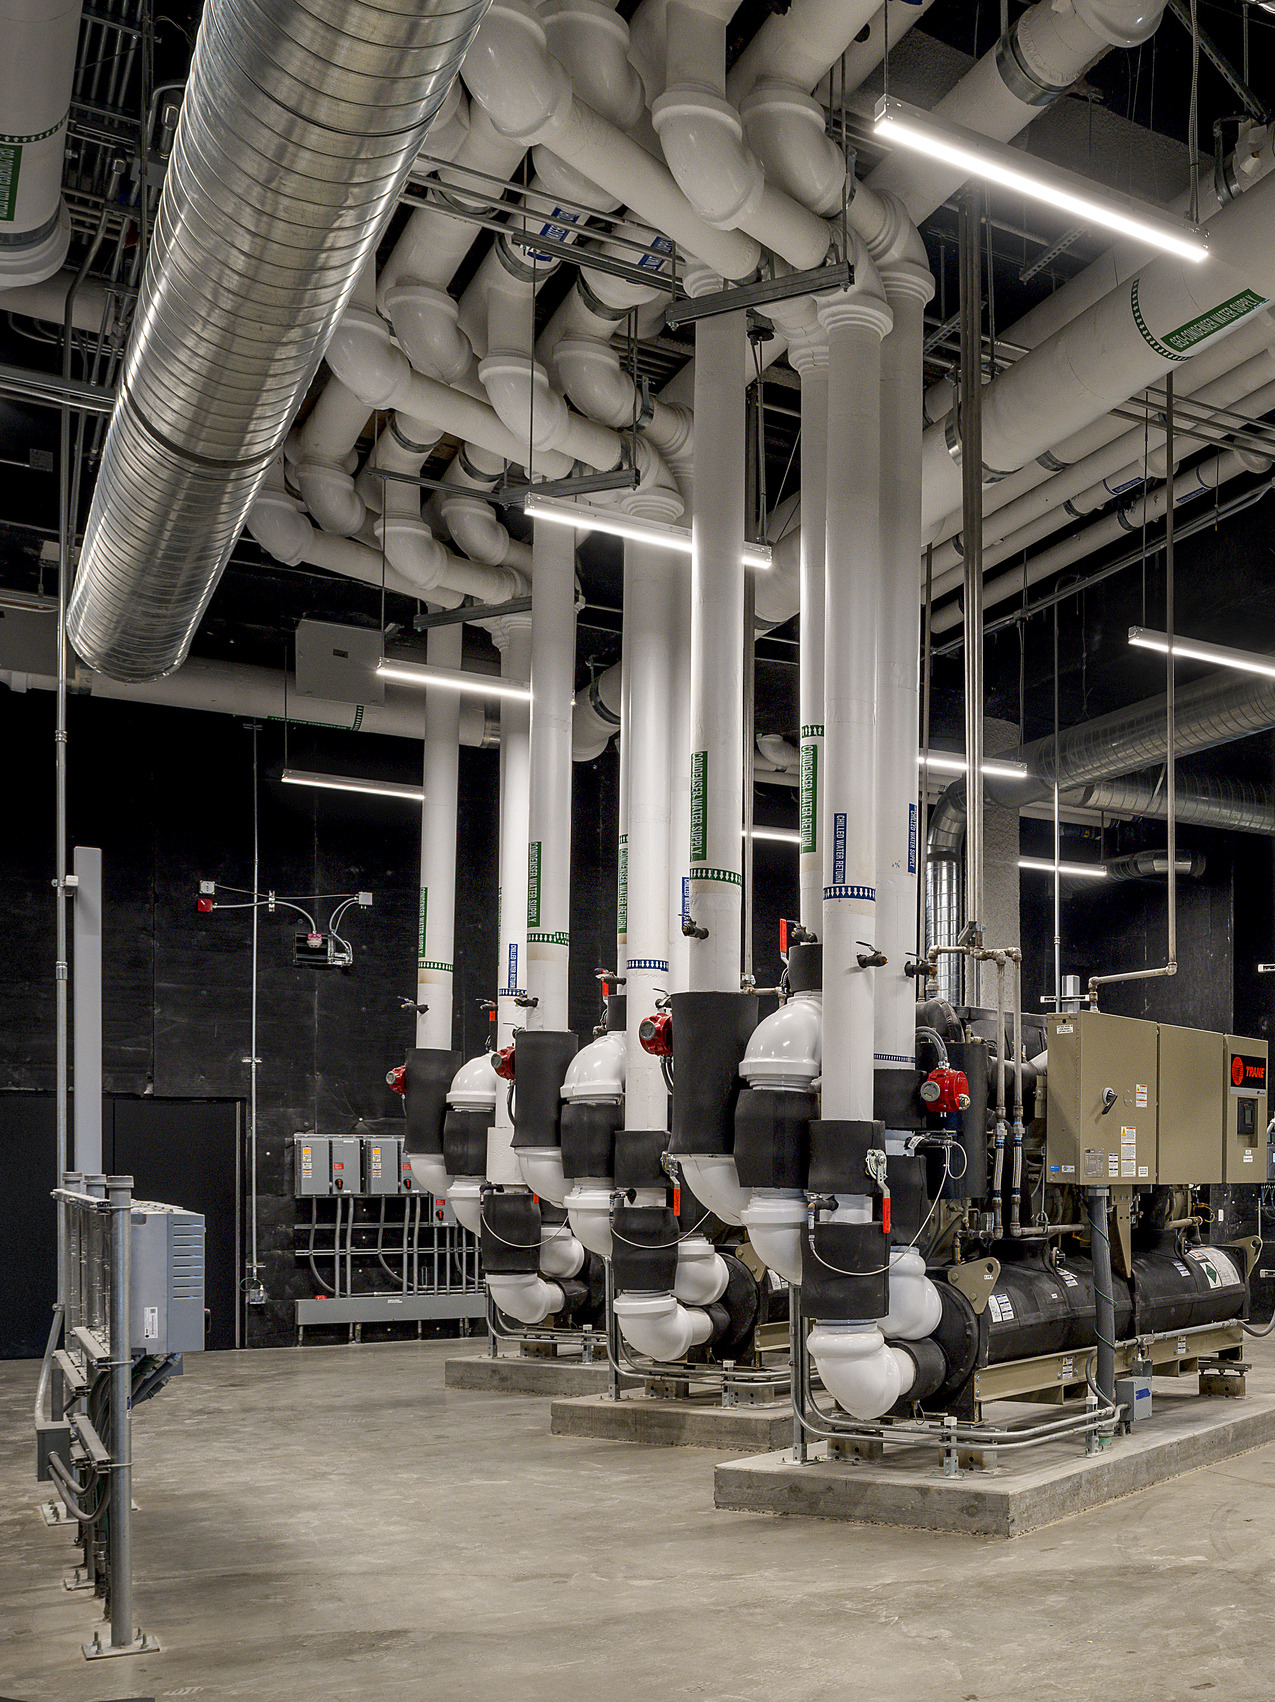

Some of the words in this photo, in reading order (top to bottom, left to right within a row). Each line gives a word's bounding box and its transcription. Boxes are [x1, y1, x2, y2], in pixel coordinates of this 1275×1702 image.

[1210, 307, 1239, 324] WATER
[1230, 294, 1260, 313] SUPPLY
[692, 752, 704, 798] CONDENSER
[801, 745, 813, 790] CONDENSER
[692, 798, 703, 825] WATER
[801, 791, 813, 818] WATER
[801, 818, 812, 848] RETURN
[836, 814, 845, 839] CHILLED
[691, 826, 703, 855] SUPPLY
[836, 840, 845, 859] WATER
[529, 842, 538, 877] CONDENSER
[835, 860, 844, 884] RETURN
[529, 877, 538, 898] WATER
[619, 884, 627, 904] WATER
[528, 900, 537, 923] SUPPLY
[618, 906, 627, 928] RETURN
[1246, 1066, 1266, 1079] TRANE
